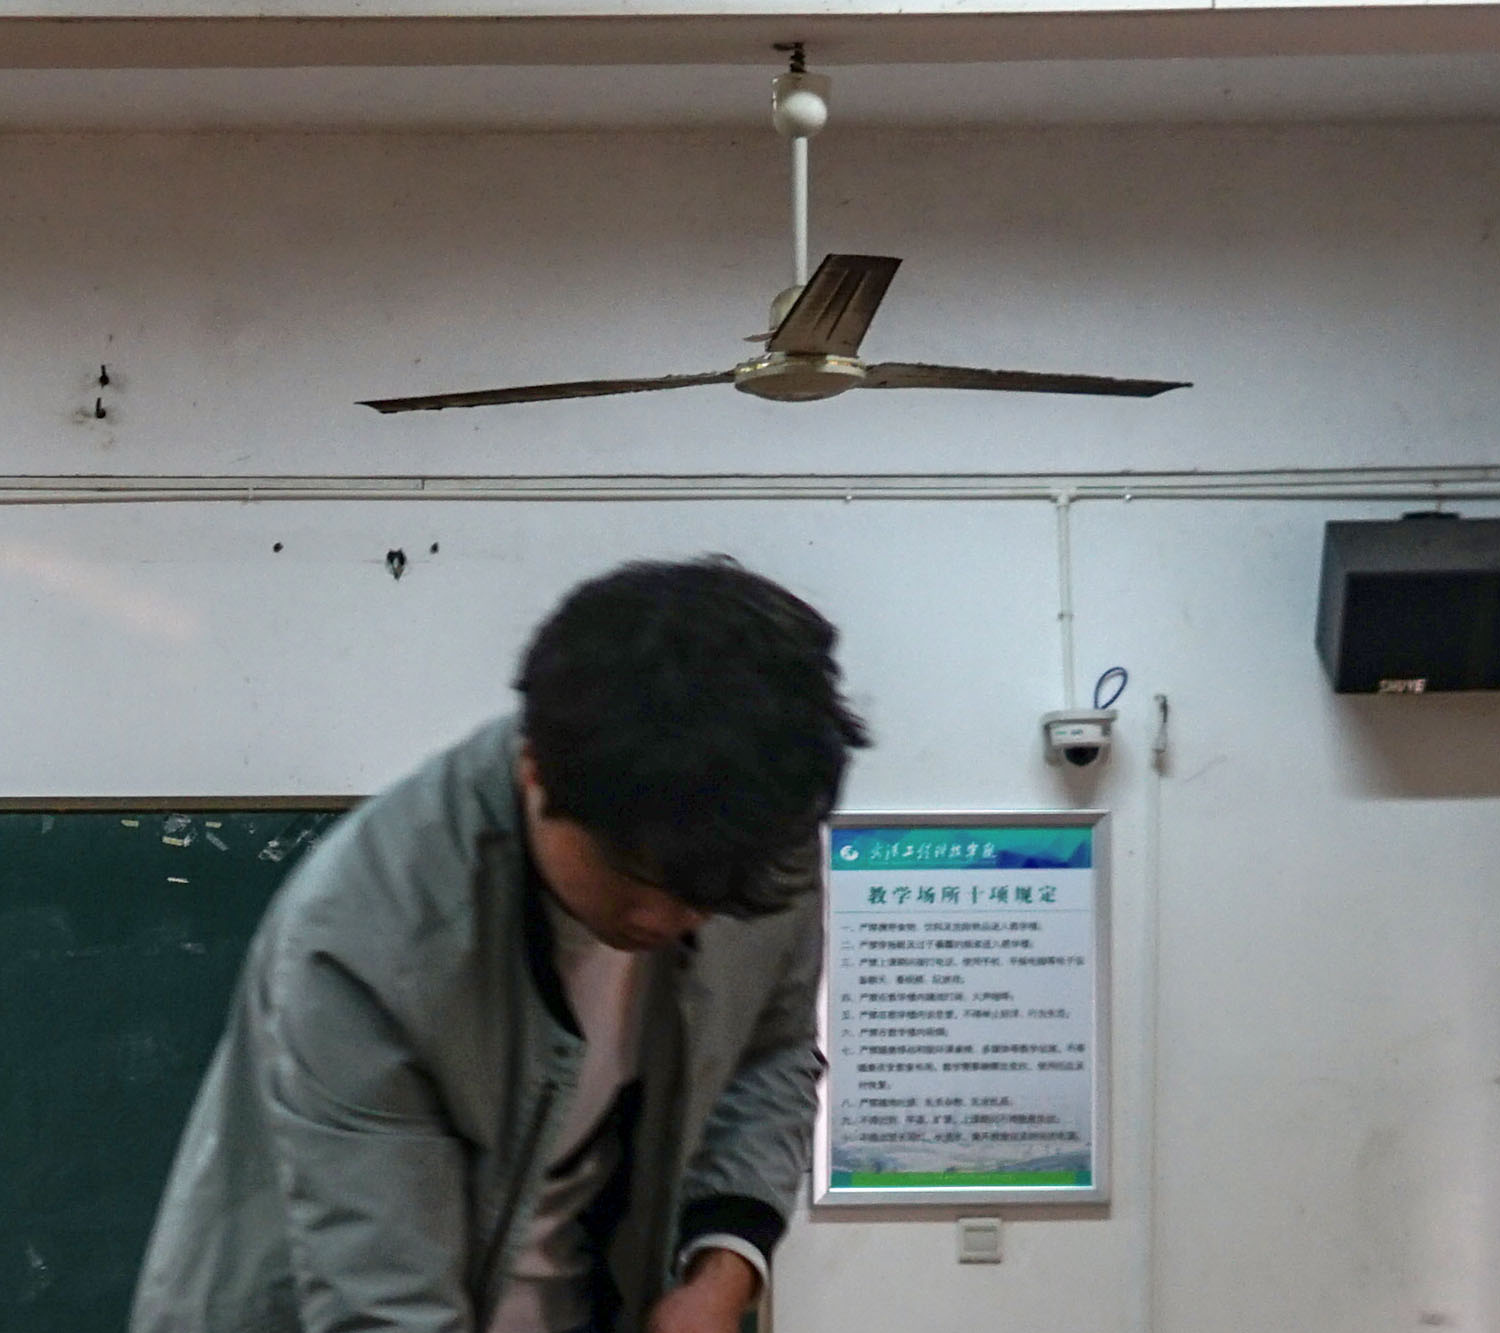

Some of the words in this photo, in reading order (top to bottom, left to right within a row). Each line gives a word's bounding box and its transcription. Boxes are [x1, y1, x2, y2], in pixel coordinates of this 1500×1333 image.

[868, 885, 1057, 904] 教学场所十项规定
